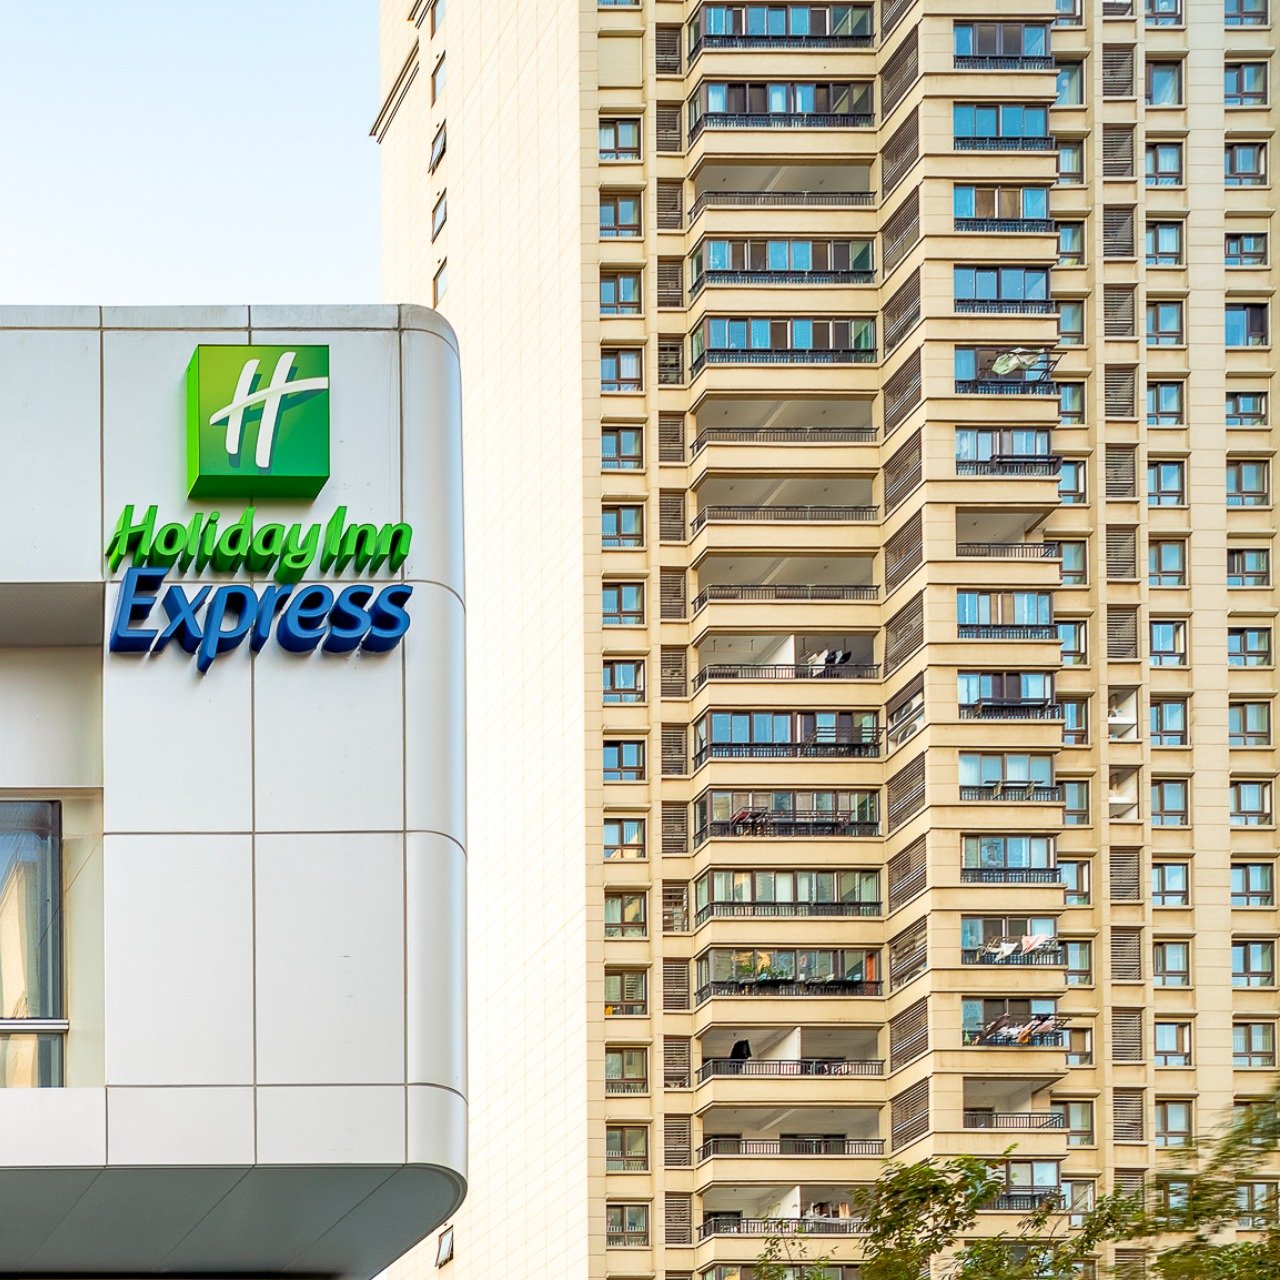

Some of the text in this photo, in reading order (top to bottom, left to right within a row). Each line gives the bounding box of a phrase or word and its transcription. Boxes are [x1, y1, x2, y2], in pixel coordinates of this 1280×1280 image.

[106, 504, 413, 582] Holiday Inn
[109, 566, 413, 673] Express
